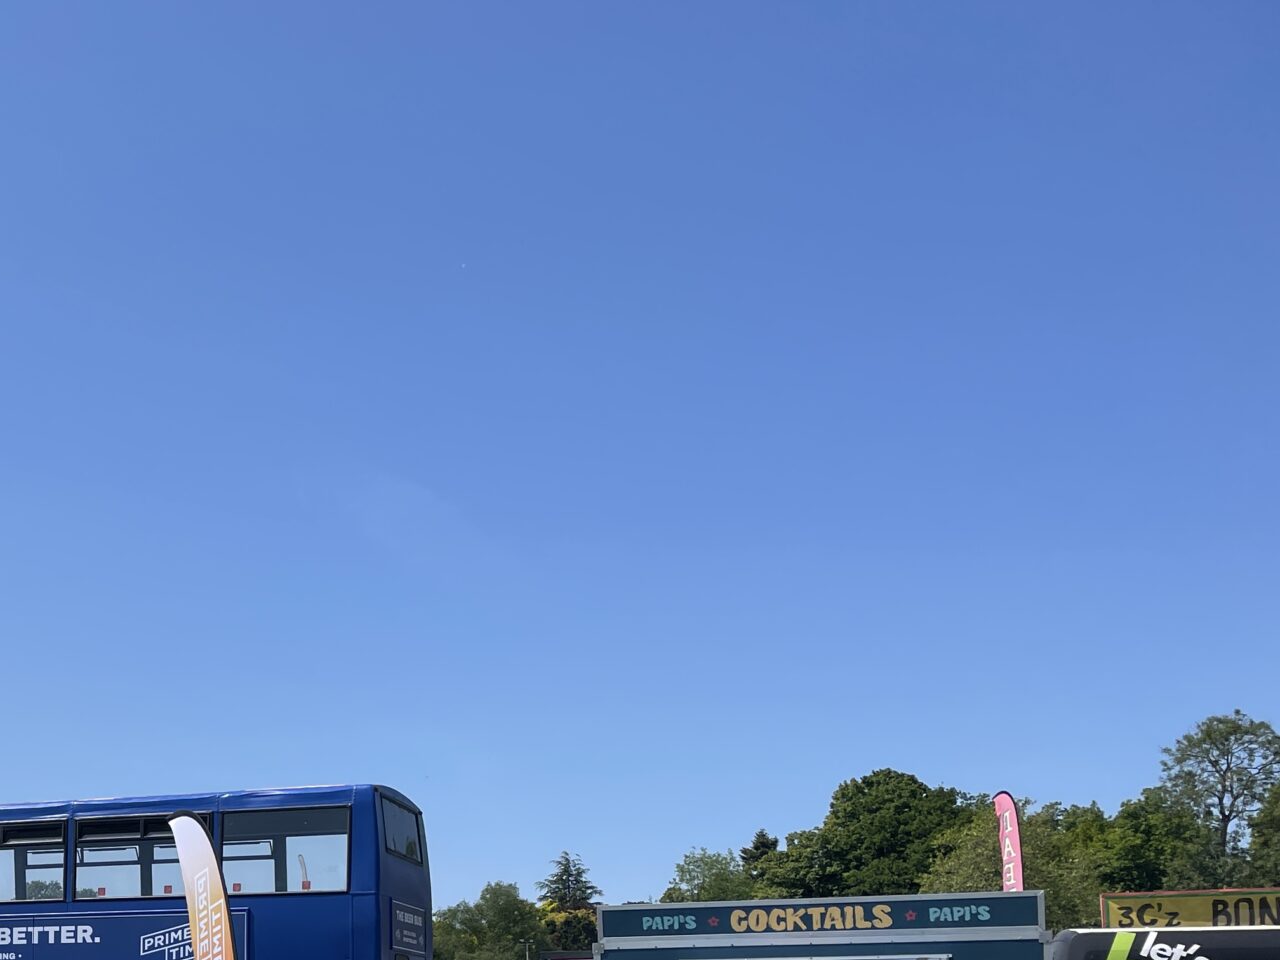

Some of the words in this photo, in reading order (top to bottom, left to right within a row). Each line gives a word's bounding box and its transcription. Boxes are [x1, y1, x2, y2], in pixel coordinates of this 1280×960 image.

[642, 915, 697, 931] PAPI'S
[730, 904, 893, 932] COCKTAILS
[928, 905, 991, 922] PAPI'S
[145, 928, 191, 951] PRIME
[170, 945, 195, 960] TIM
